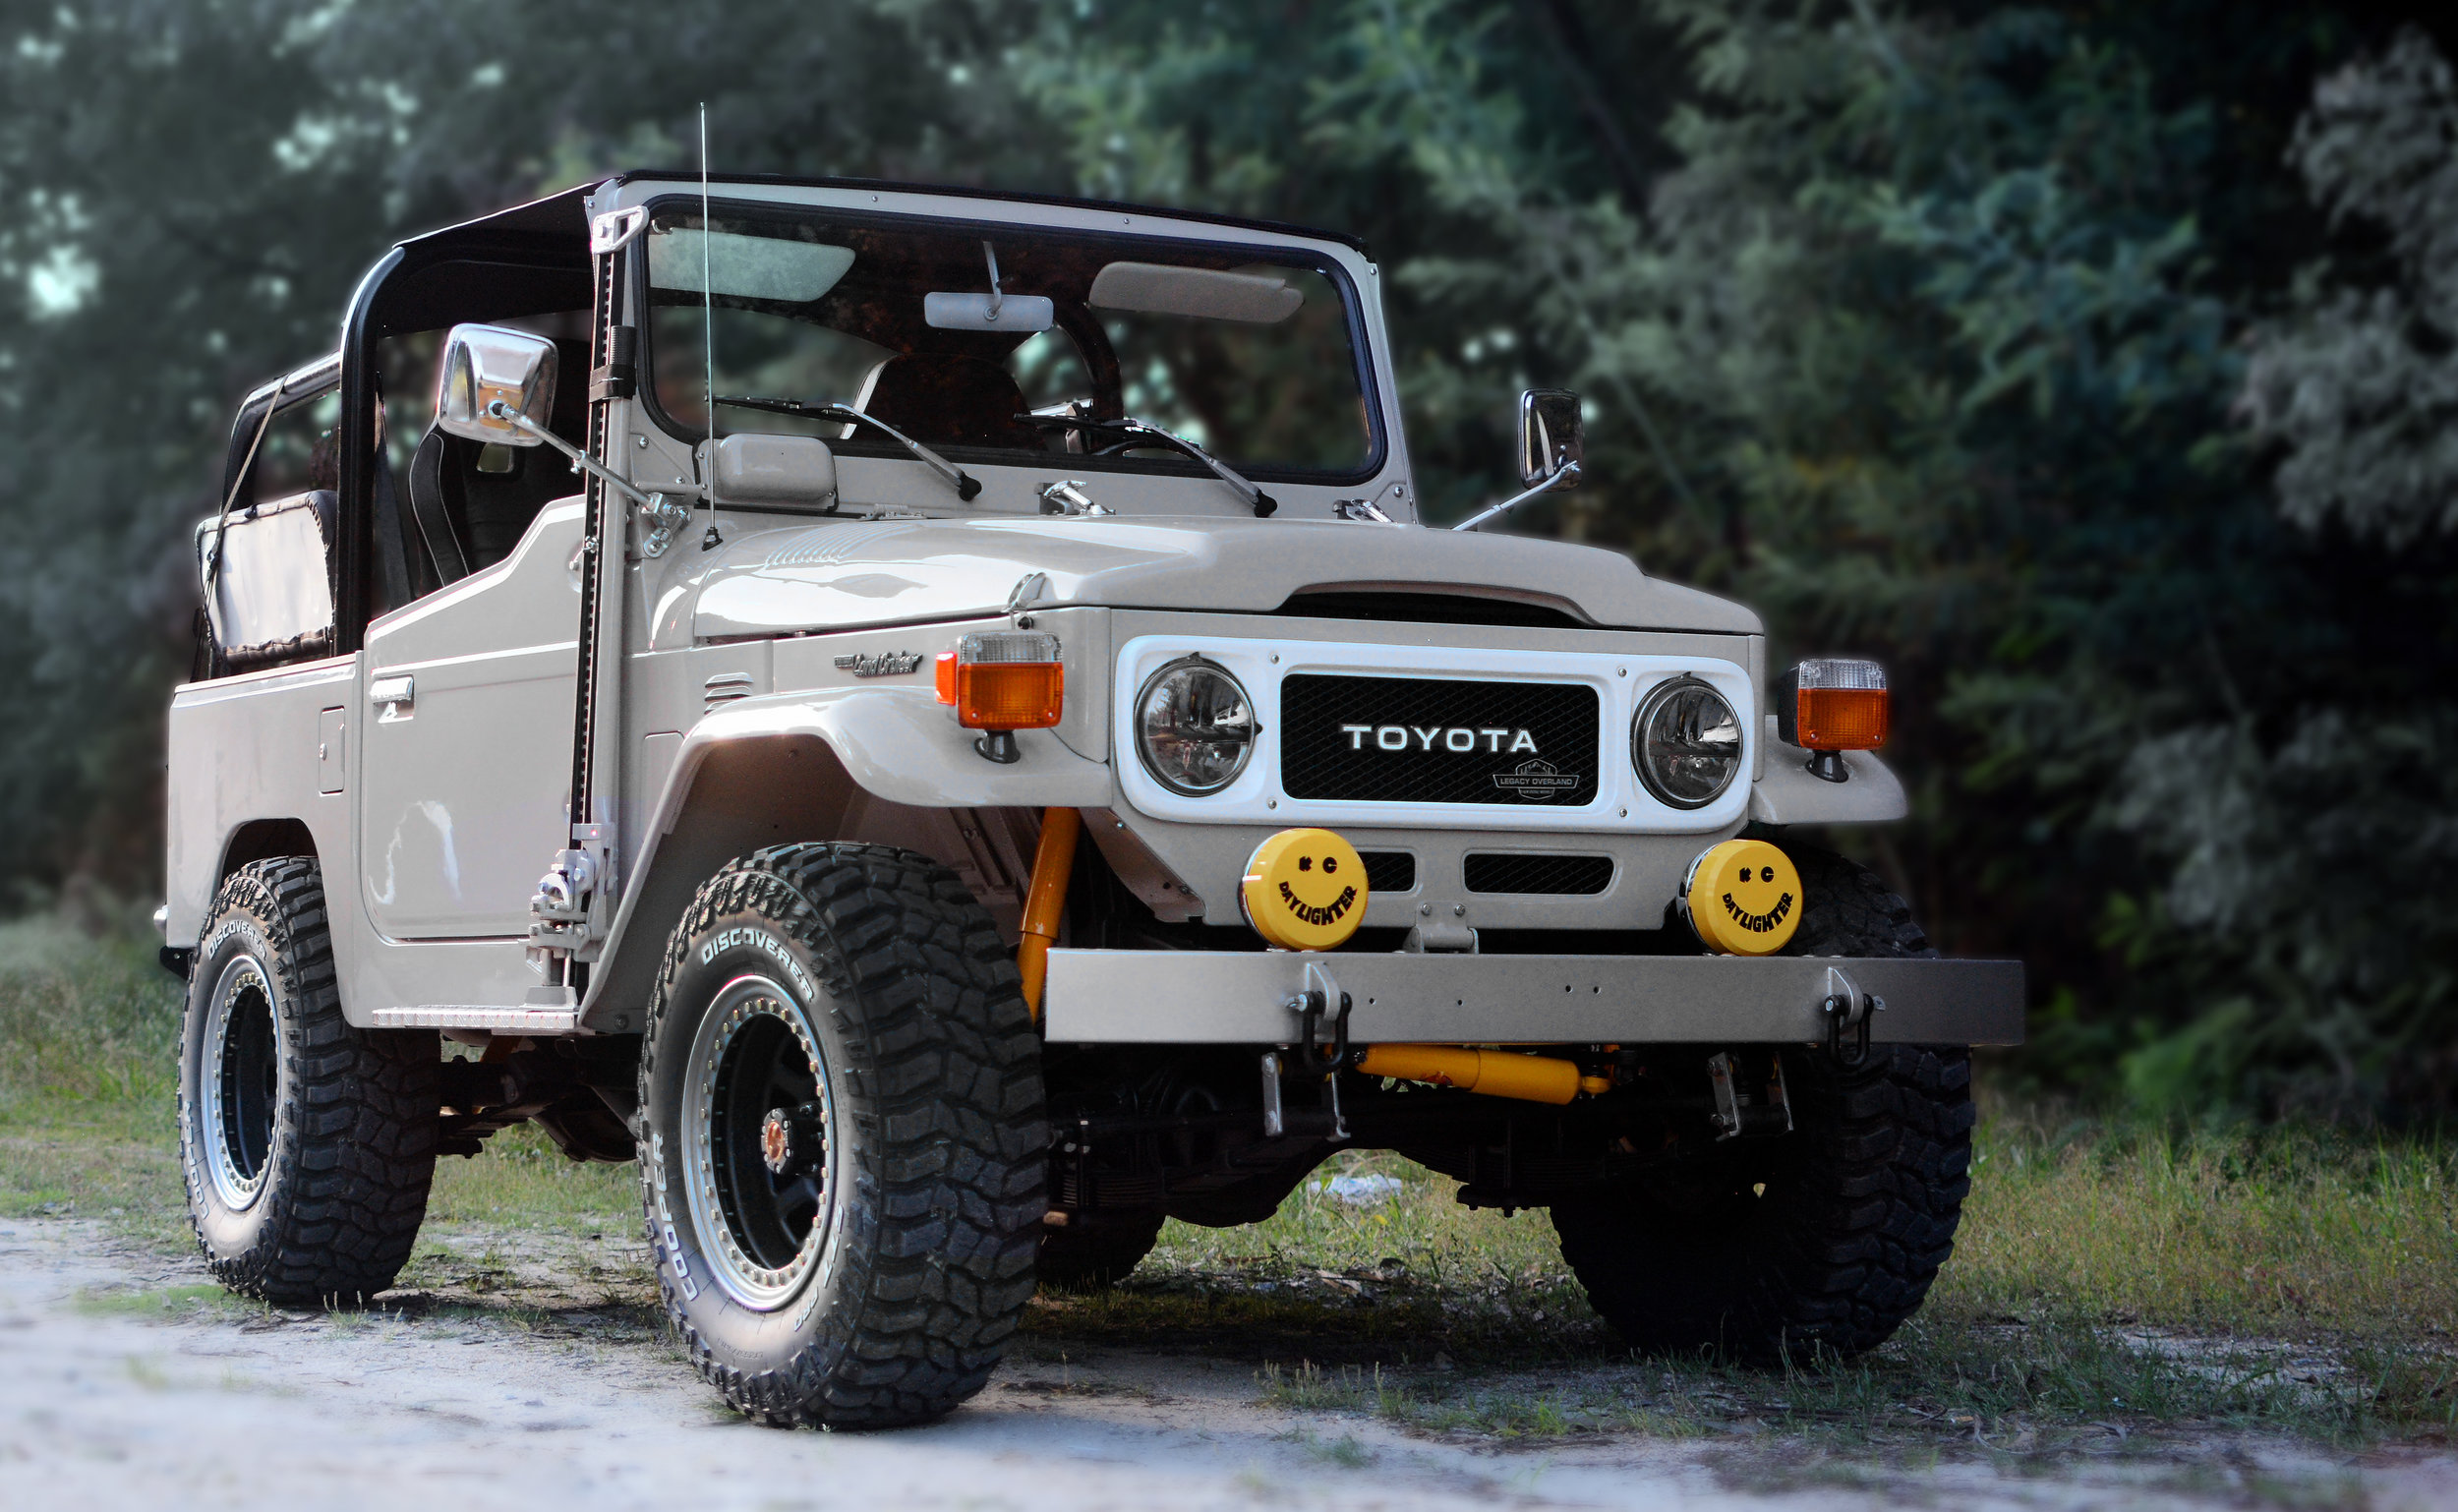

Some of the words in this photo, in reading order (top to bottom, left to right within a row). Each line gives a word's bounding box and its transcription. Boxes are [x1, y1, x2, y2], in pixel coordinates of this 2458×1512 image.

[1341, 725, 1538, 752] TOYOTA
[1278, 881, 1358, 926] DAYLIGHTER
[1723, 892, 1793, 933] DAYLIGHTER
[207, 919, 266, 960] DISCOVERER
[701, 927, 814, 1002] DISCOVERER
[653, 1133, 698, 1301] COOPER
